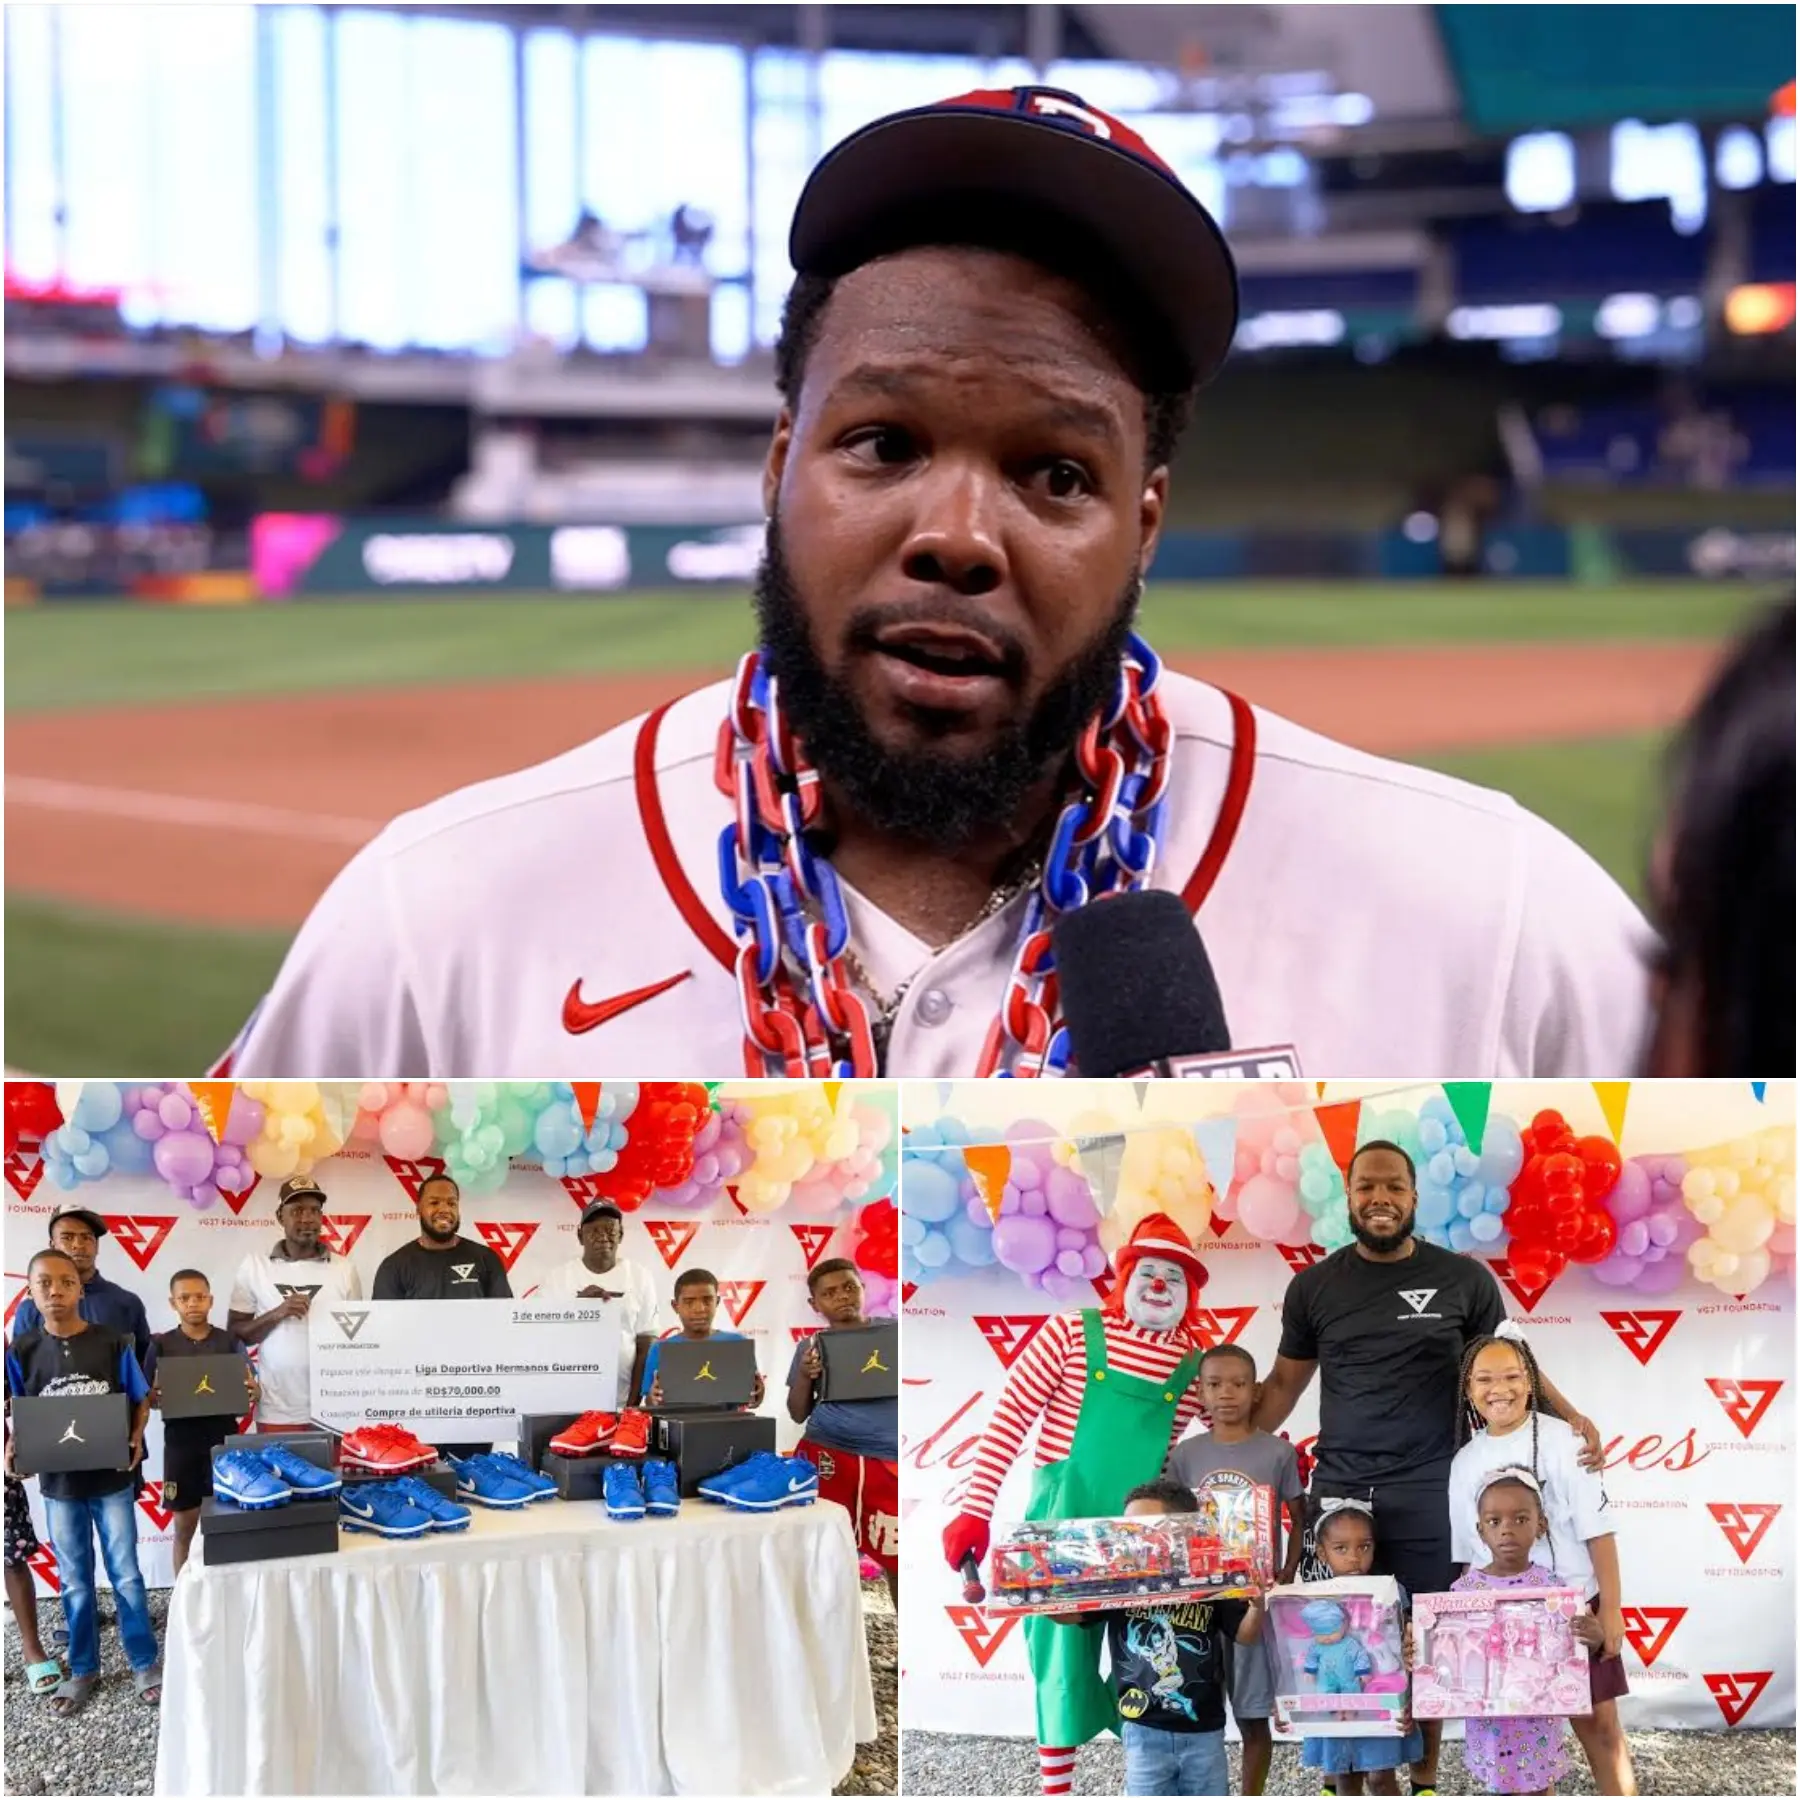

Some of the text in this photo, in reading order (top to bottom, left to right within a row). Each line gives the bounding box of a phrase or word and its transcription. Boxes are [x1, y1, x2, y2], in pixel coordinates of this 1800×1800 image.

[1724, 1303, 1782, 1313] FOUNDATION
[512, 1310, 600, 1320] 3 de enero de 2025
[415, 1364, 437, 1376] Liga
[441, 1364, 492, 1375] Deportiva
[496, 1364, 549, 1373] Hermanos
[552, 1362, 599, 1371] Guerrero
[425, 1386, 501, 1397] RD$70,000.00
[365, 1408, 406, 1419] Compra
[409, 1407, 422, 1416] de
[466, 1405, 516, 1417] deportiva
